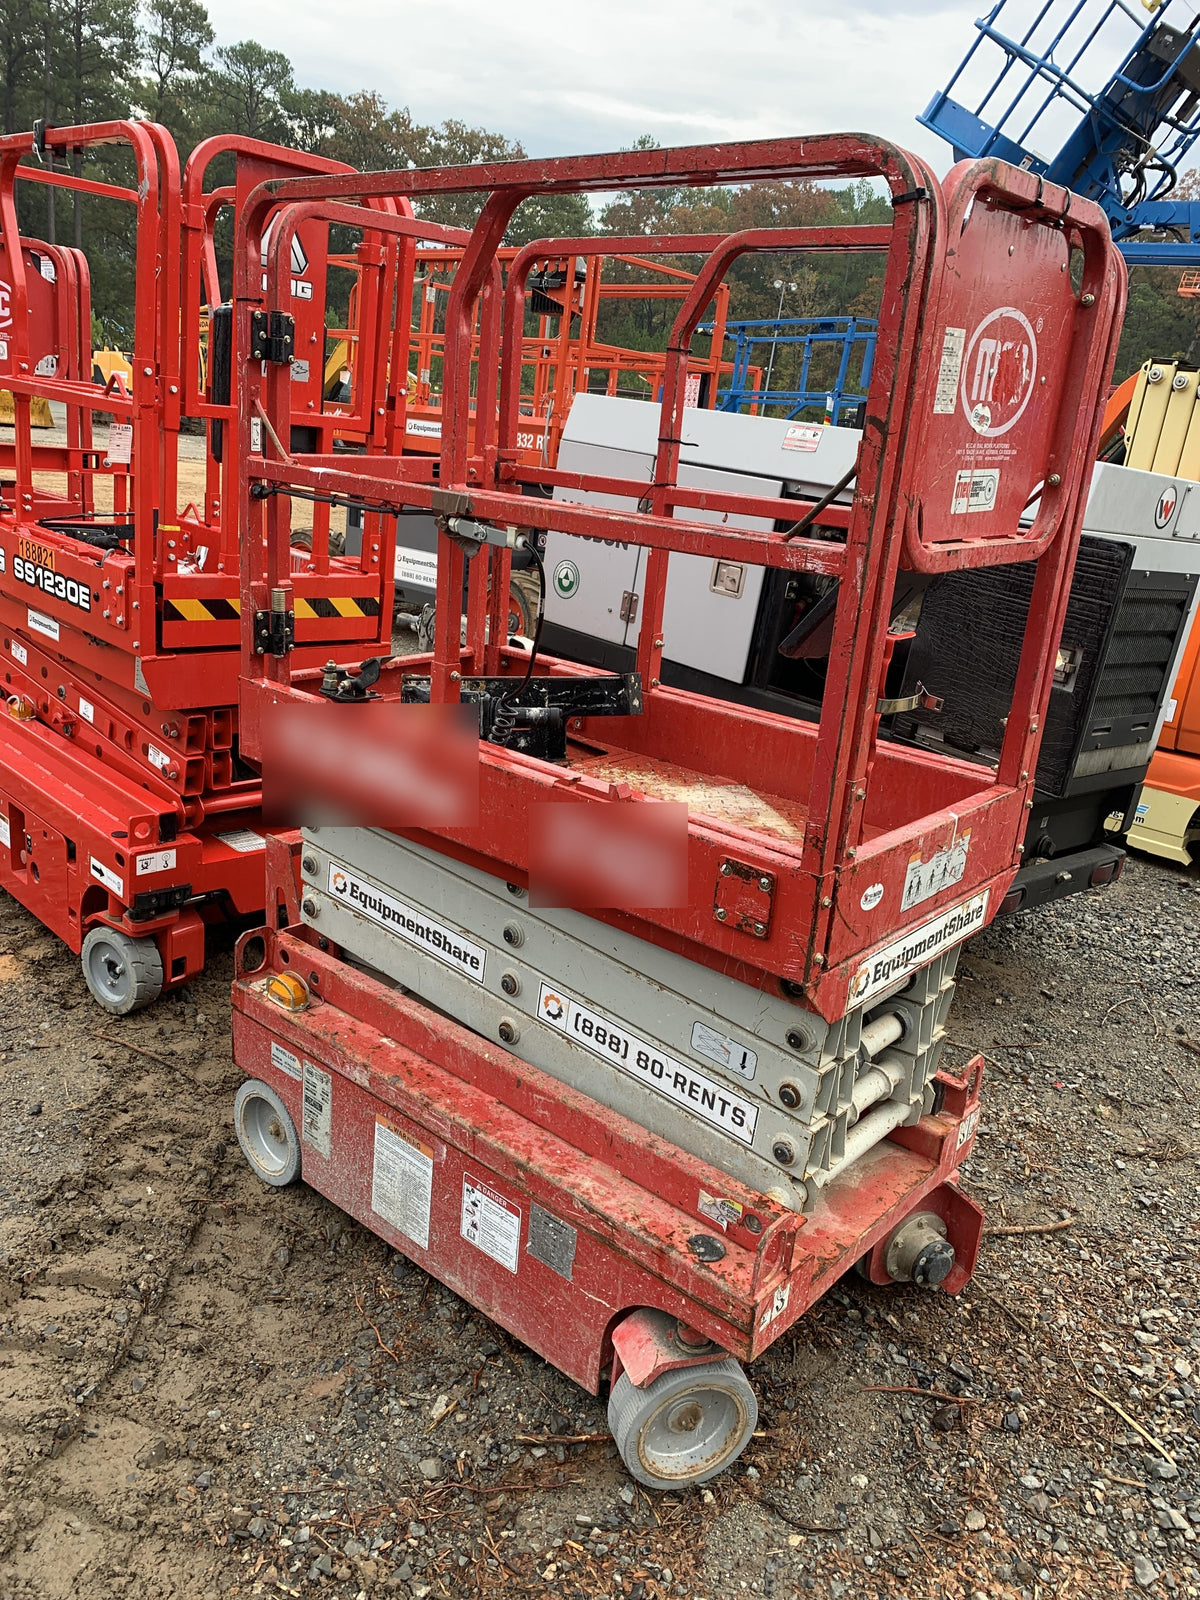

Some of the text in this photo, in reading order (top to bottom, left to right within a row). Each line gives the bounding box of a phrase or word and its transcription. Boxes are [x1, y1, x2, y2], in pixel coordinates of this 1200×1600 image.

[413, 423, 442, 433] Equipment
[19, 539, 54, 569] 188021
[402, 555, 438, 568] EquipmentSh
[14, 556, 90, 611] SS1230E
[349, 881, 480, 971] EquipmentShare
[871, 904, 984, 985] EquipmentShare
[574, 1012, 747, 1128] (888) 80-RENTS
[393, 1126, 421, 1150] WARNING
[482, 1187, 507, 1208] DANGER
